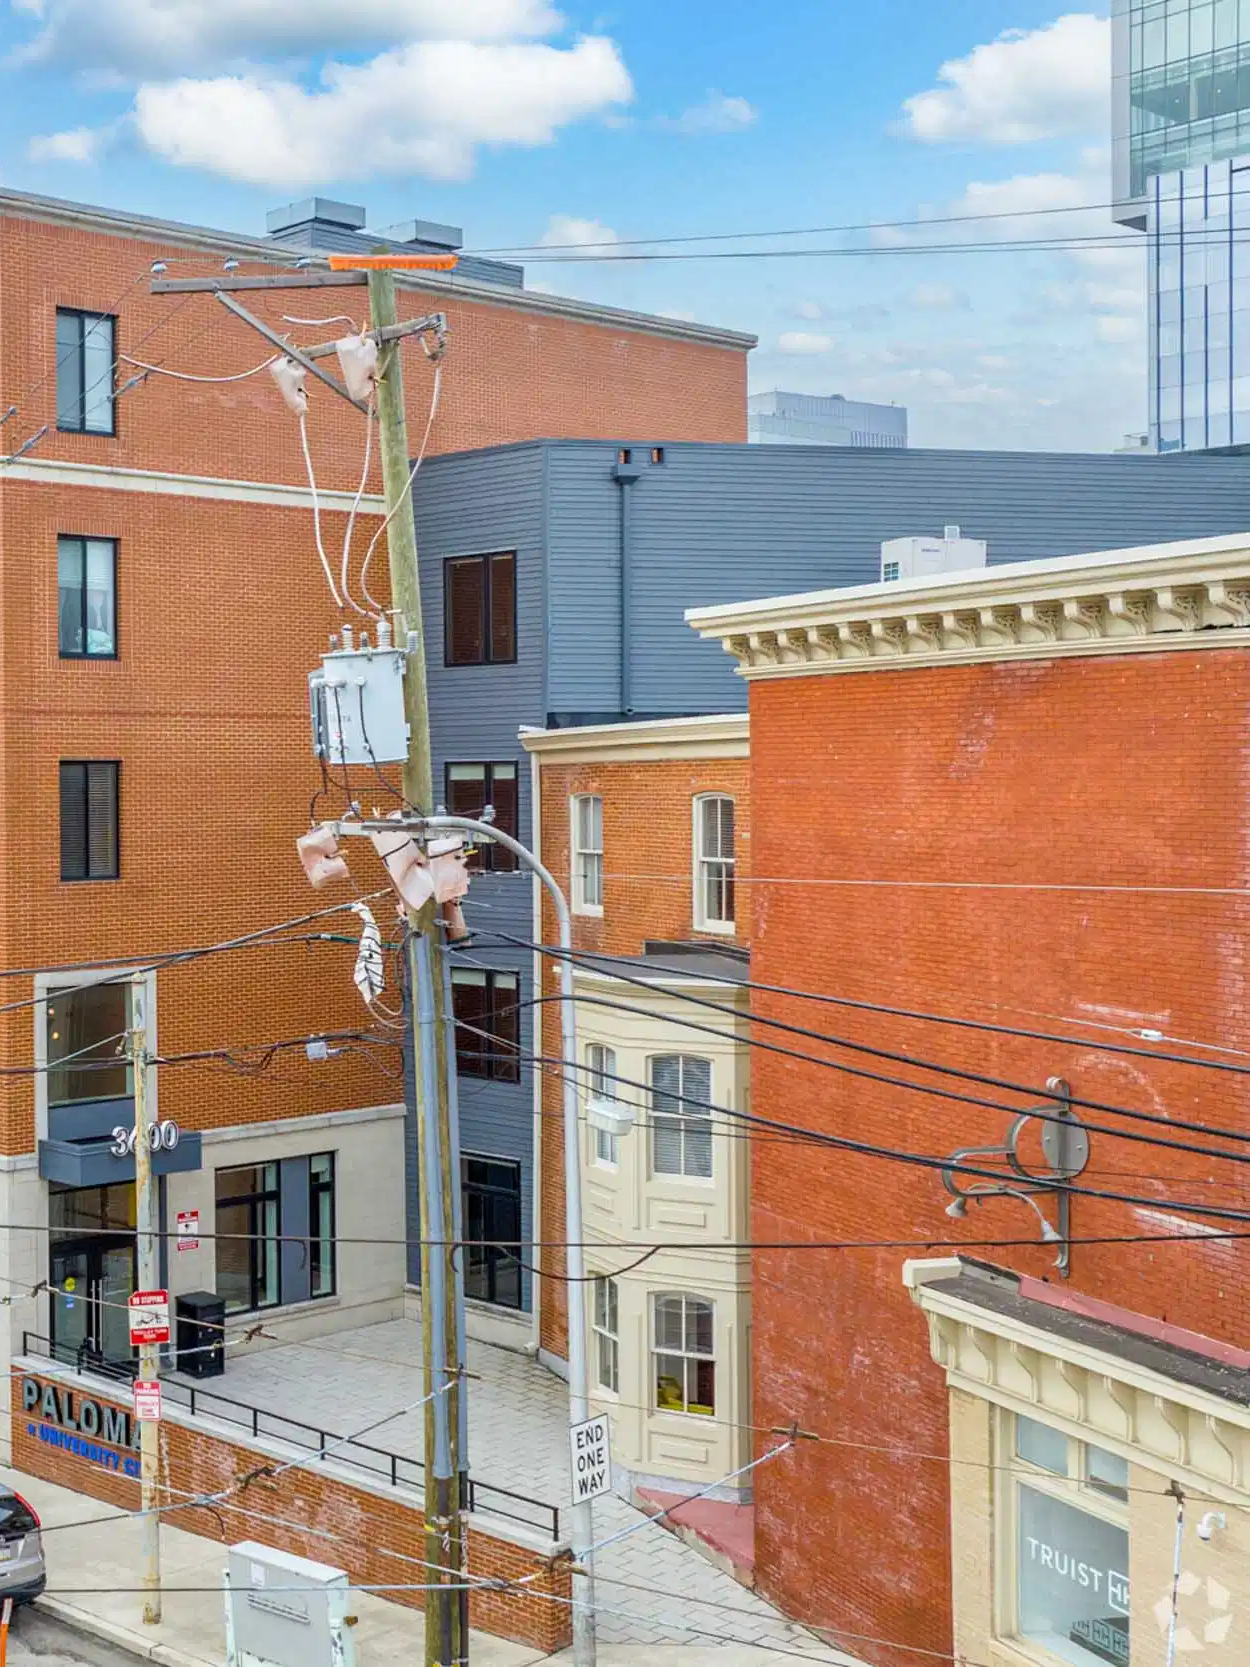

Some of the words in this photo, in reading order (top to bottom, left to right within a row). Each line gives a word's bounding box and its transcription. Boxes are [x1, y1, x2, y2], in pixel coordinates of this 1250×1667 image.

[576, 1424, 604, 1449] END
[577, 1446, 605, 1473] ONE
[578, 1469, 606, 1497] WAY
[1026, 1536, 1104, 1593] TRUIST
